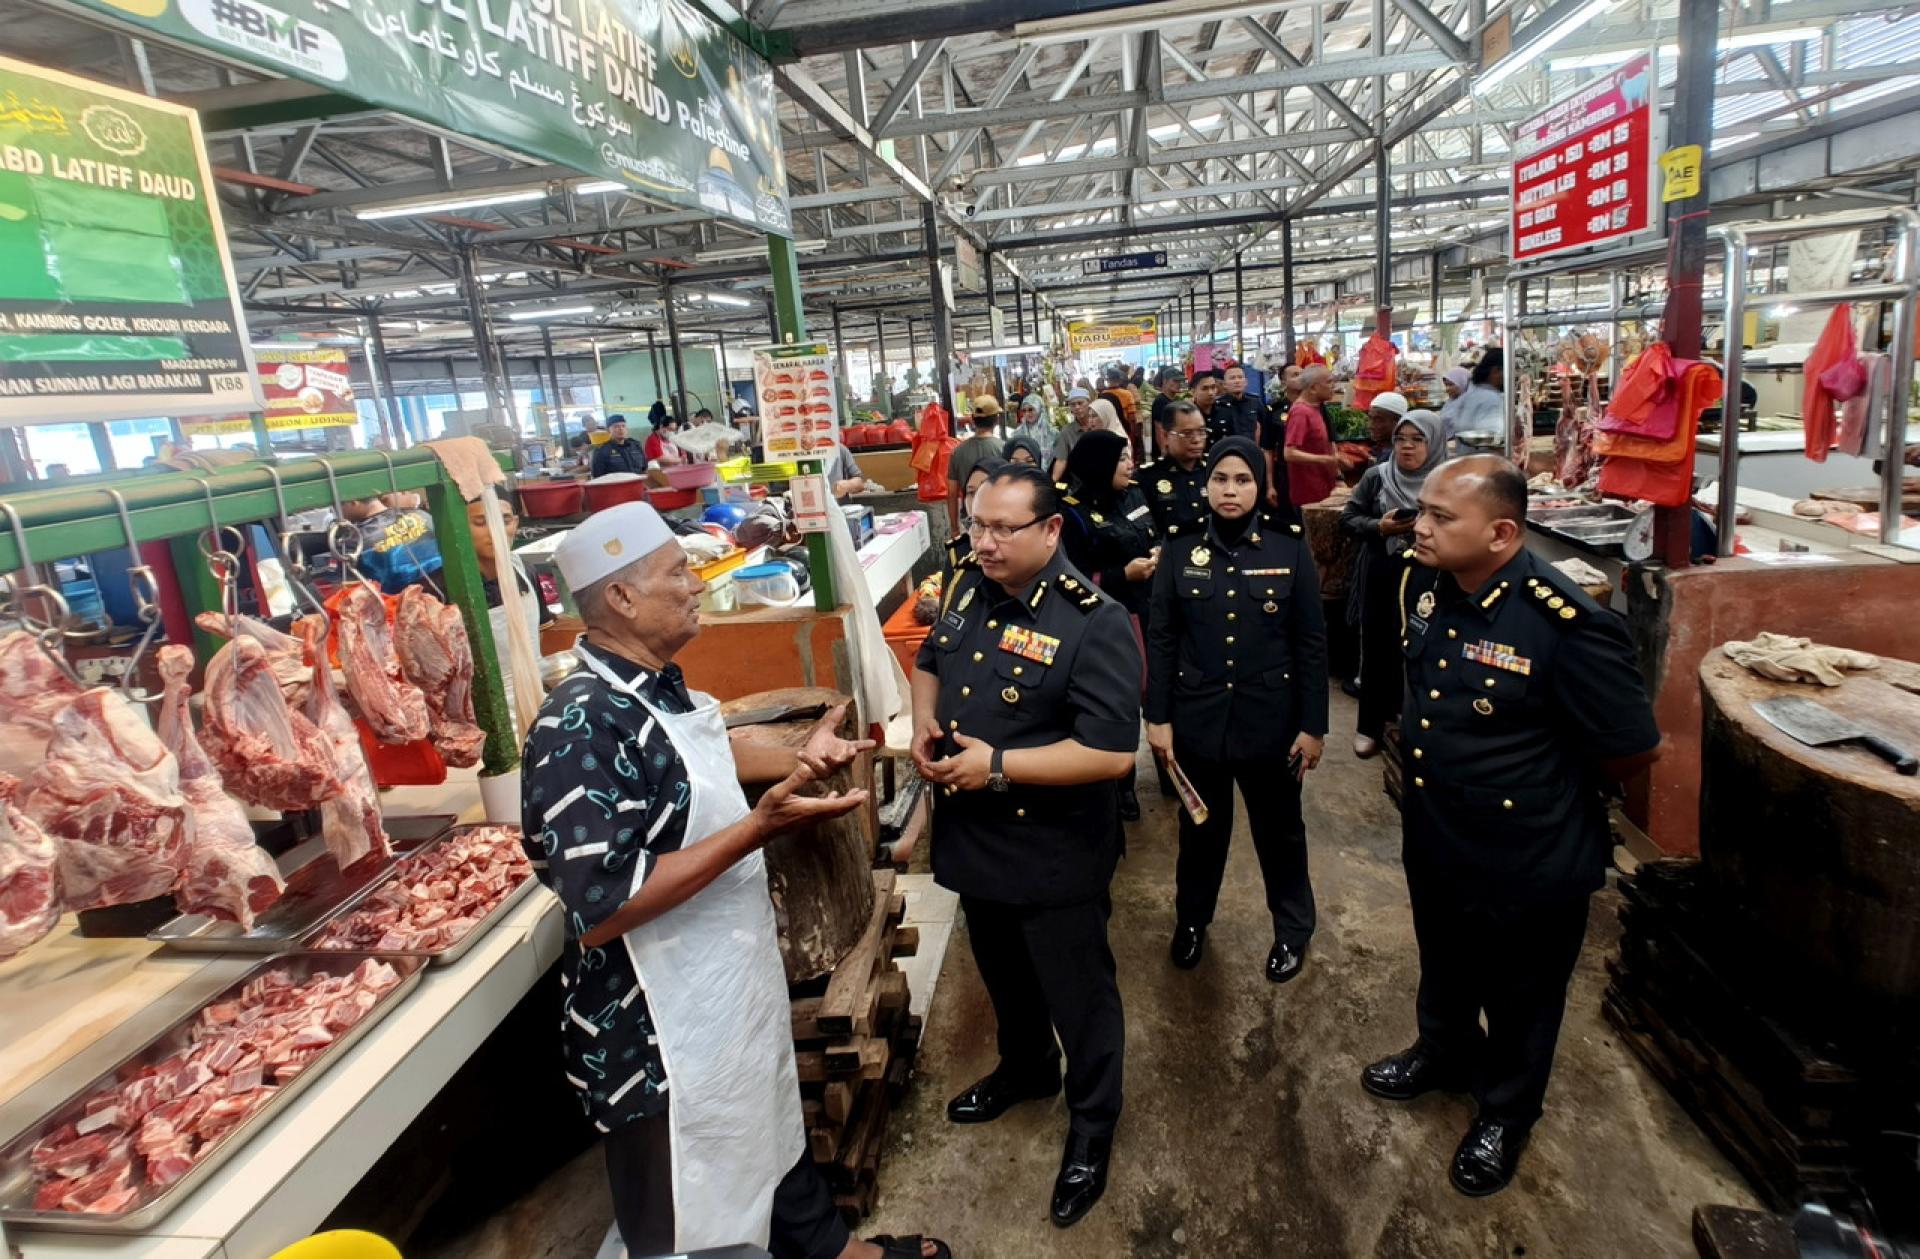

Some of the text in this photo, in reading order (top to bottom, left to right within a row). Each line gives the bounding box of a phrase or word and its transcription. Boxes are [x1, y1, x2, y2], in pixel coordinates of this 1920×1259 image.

[210, 0, 319, 54] #BMF
[577, 0, 658, 81] LATIFF
[478, 0, 598, 81] LATIFF
[601, 52, 672, 124] DAUD
[509, 65, 565, 106] مسلم
[675, 99, 751, 163] Palestine
[51, 151, 133, 190] LATIFF
[138, 168, 196, 201] DAUD
[1557, 171, 1576, 193] LEG
[1519, 226, 1562, 252] BONELESS
[1102, 258, 1138, 270] Tandas
[15, 312, 81, 331] KAMBING
[83, 314, 132, 333] GOLEK,
[132, 316, 180, 333] KENDURI
[181, 318, 231, 334] KENDARA
[35, 375, 100, 394] SUNNAH
[101, 374, 136, 391] LAGI
[137, 372, 202, 389] BARAKAH
